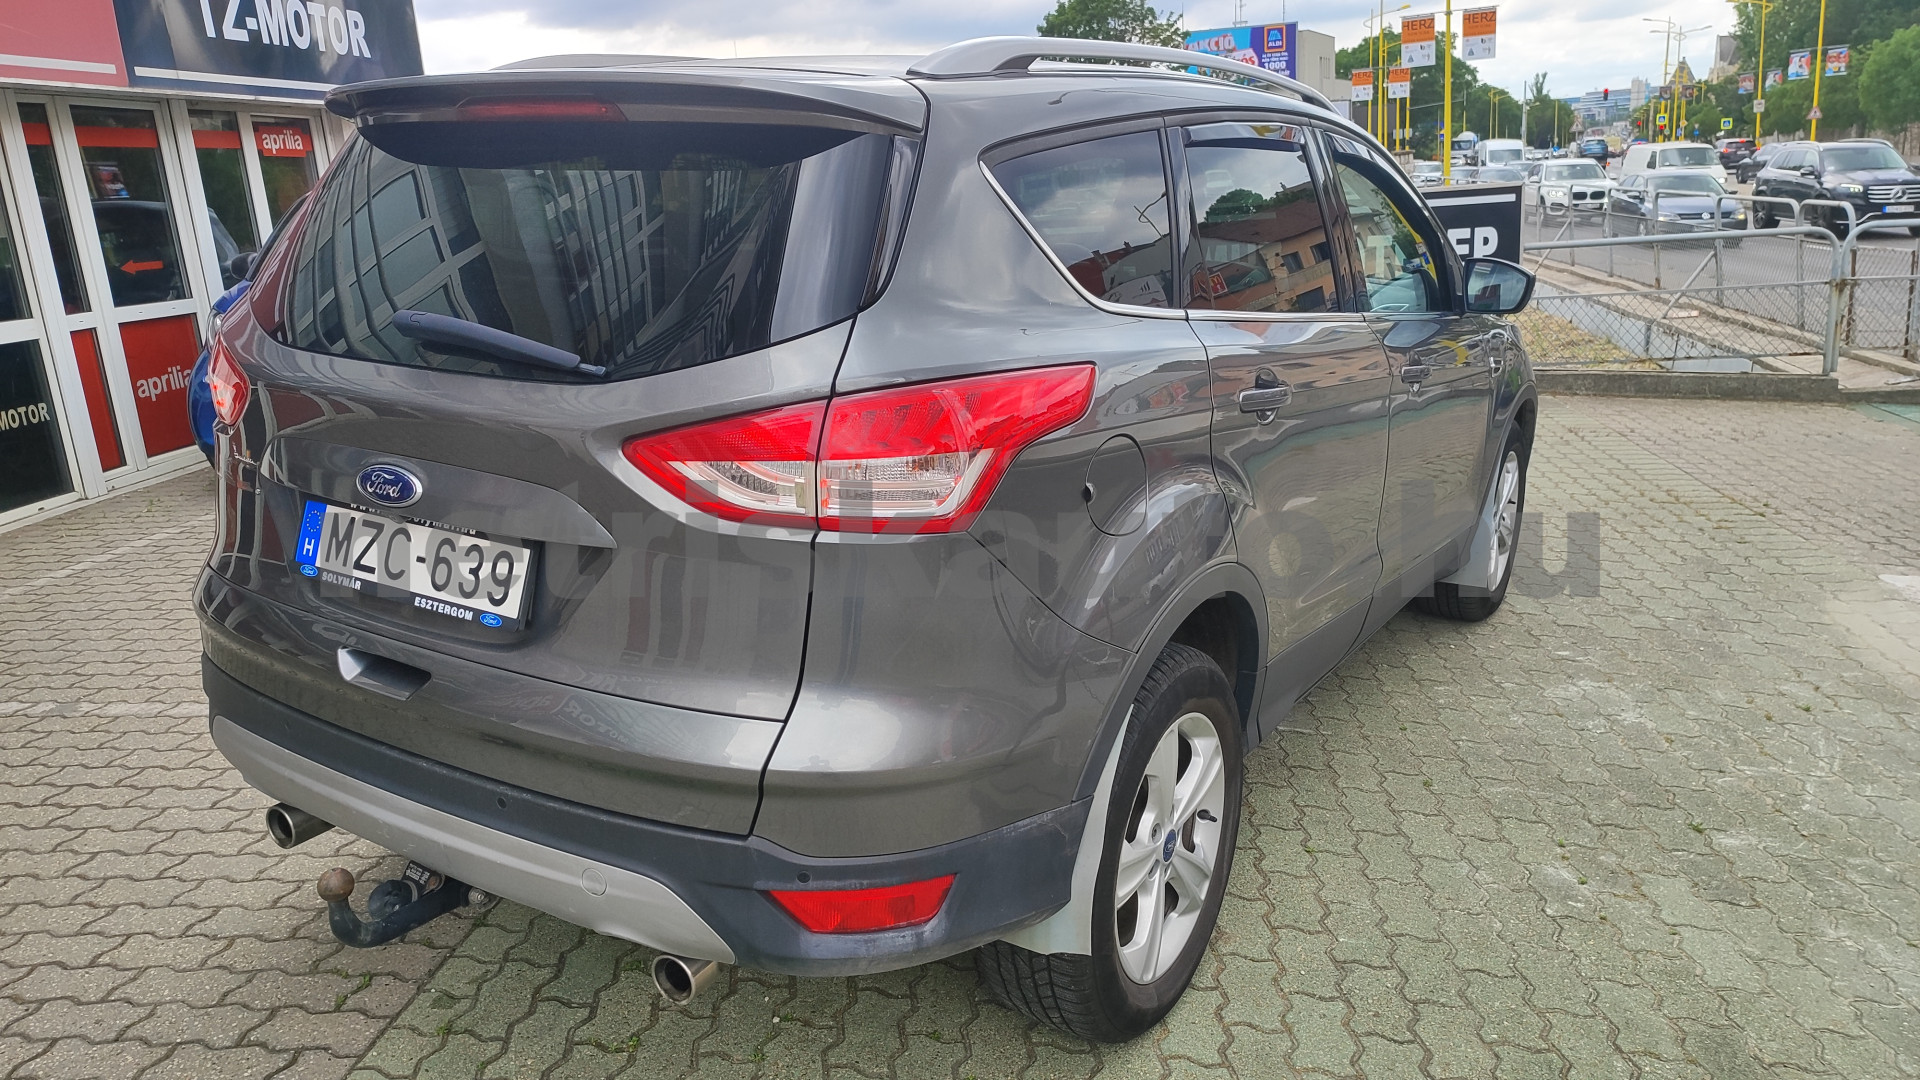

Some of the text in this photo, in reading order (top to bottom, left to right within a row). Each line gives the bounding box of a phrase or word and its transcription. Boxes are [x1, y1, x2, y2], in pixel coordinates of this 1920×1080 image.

[262, 129, 304, 154] aprilia
[366, 471, 401, 499] Ford
[303, 538, 314, 557] H
[325, 512, 515, 607] MZC-639
[322, 571, 362, 591] SOLYMÁR
[414, 596, 474, 621] ESZTERGOM
